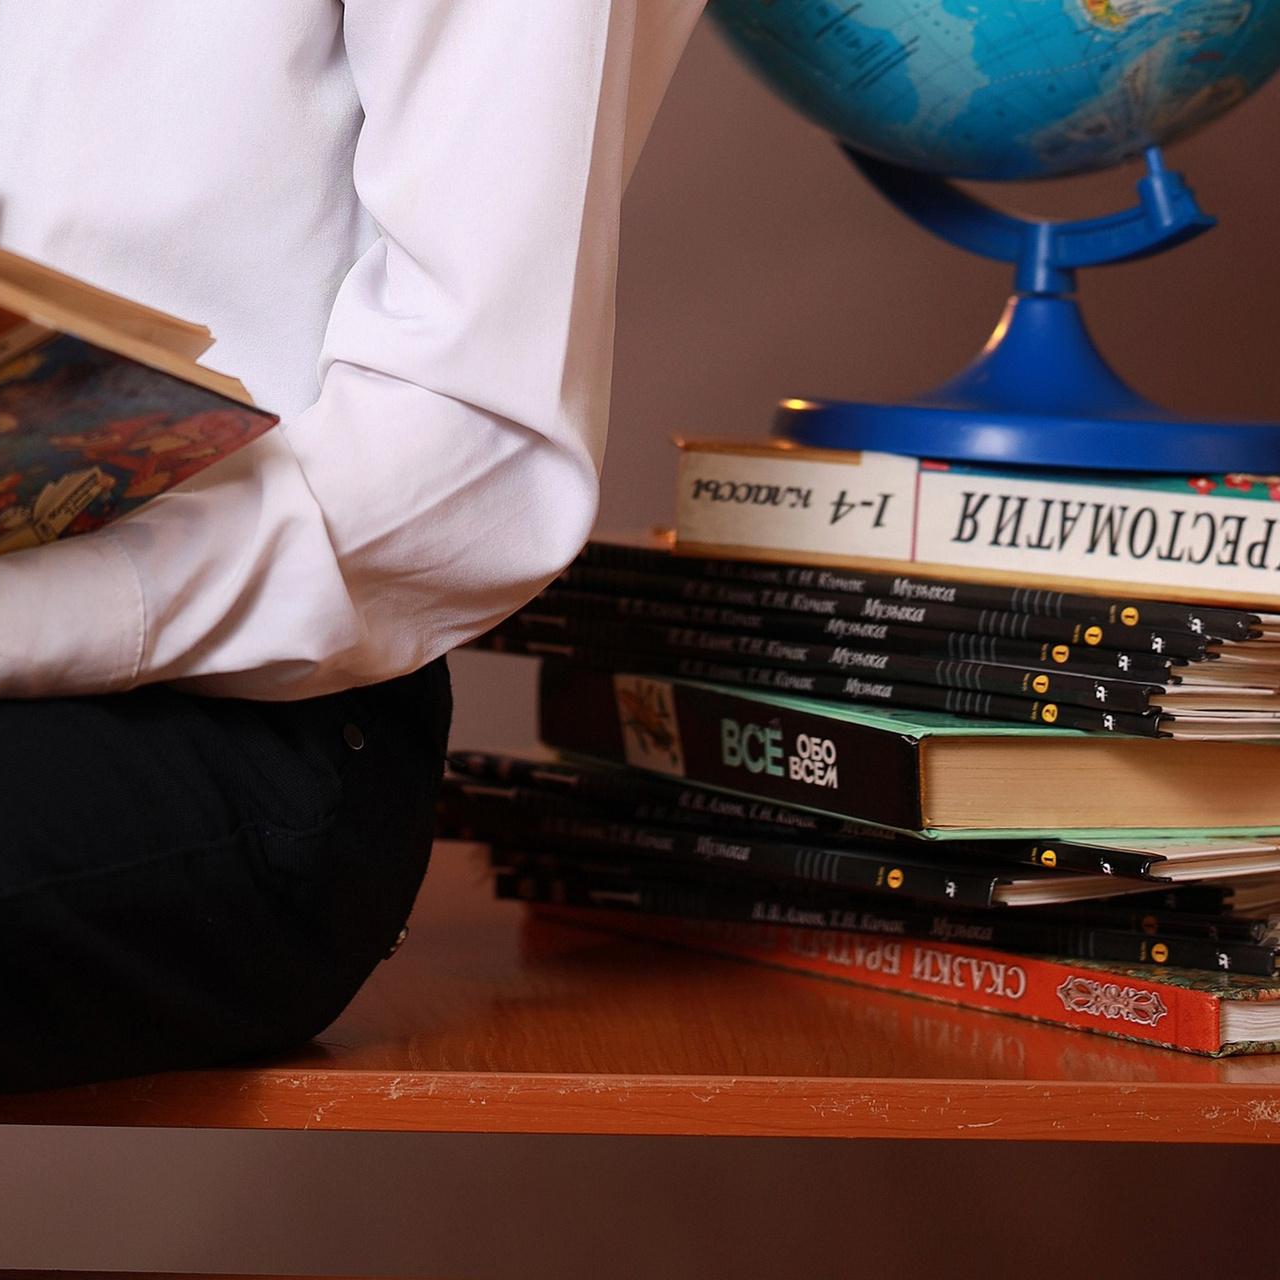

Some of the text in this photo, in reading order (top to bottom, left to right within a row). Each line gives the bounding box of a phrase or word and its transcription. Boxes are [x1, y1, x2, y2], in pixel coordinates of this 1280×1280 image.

[692, 477, 1280, 572] РЕСТОМАТИЯ 1-4 классы
[892, 577, 956, 602] Музыка
[863, 598, 926, 623] Музыка
[827, 618, 888, 639] Музыка
[830, 647, 889, 669] Музыка
[844, 677, 893, 699] Музыка
[796, 733, 837, 765] ОБО
[789, 756, 839, 789] ВСЕМ
[911, 947, 1027, 1000] СКАЗКИ
